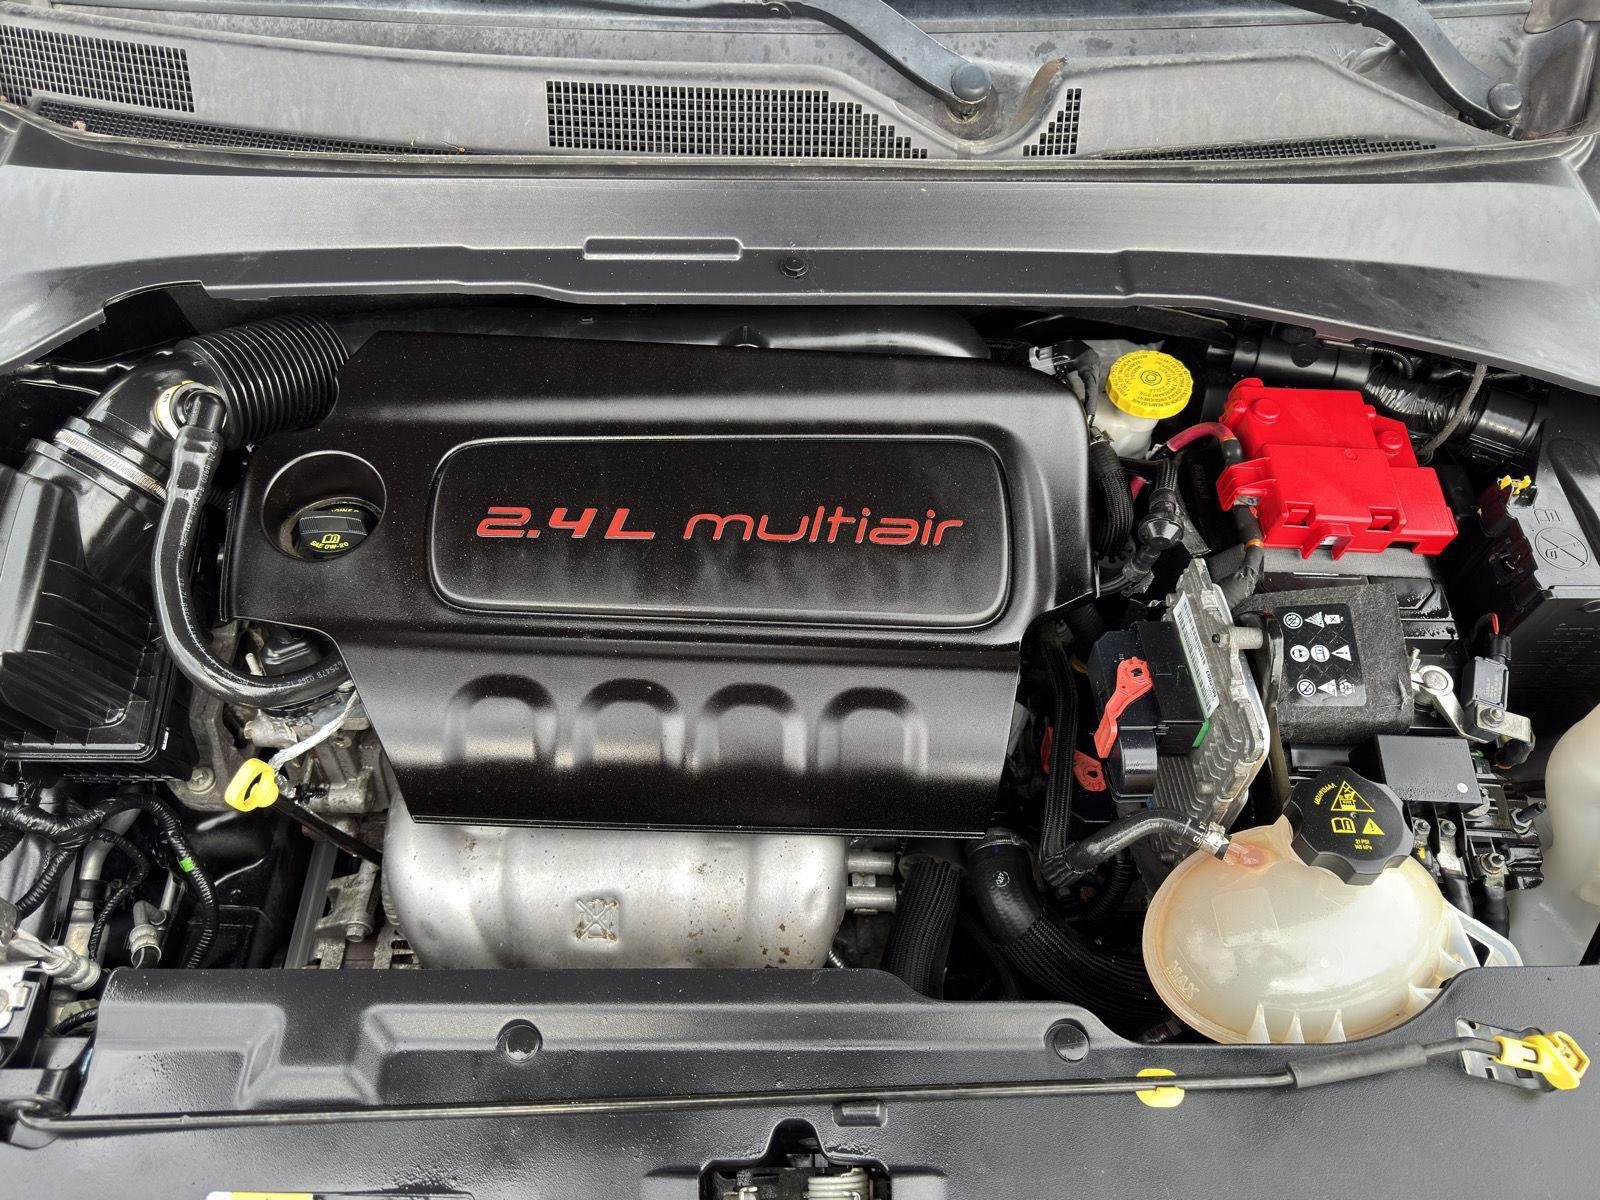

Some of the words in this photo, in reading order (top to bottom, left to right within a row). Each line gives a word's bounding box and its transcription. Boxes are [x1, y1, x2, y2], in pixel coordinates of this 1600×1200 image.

[310, 540, 324, 549] SAE
[324, 541, 349, 550] 0W-20
[683, 505, 964, 546] multiair
[1166, 960, 1200, 1000] MAX
